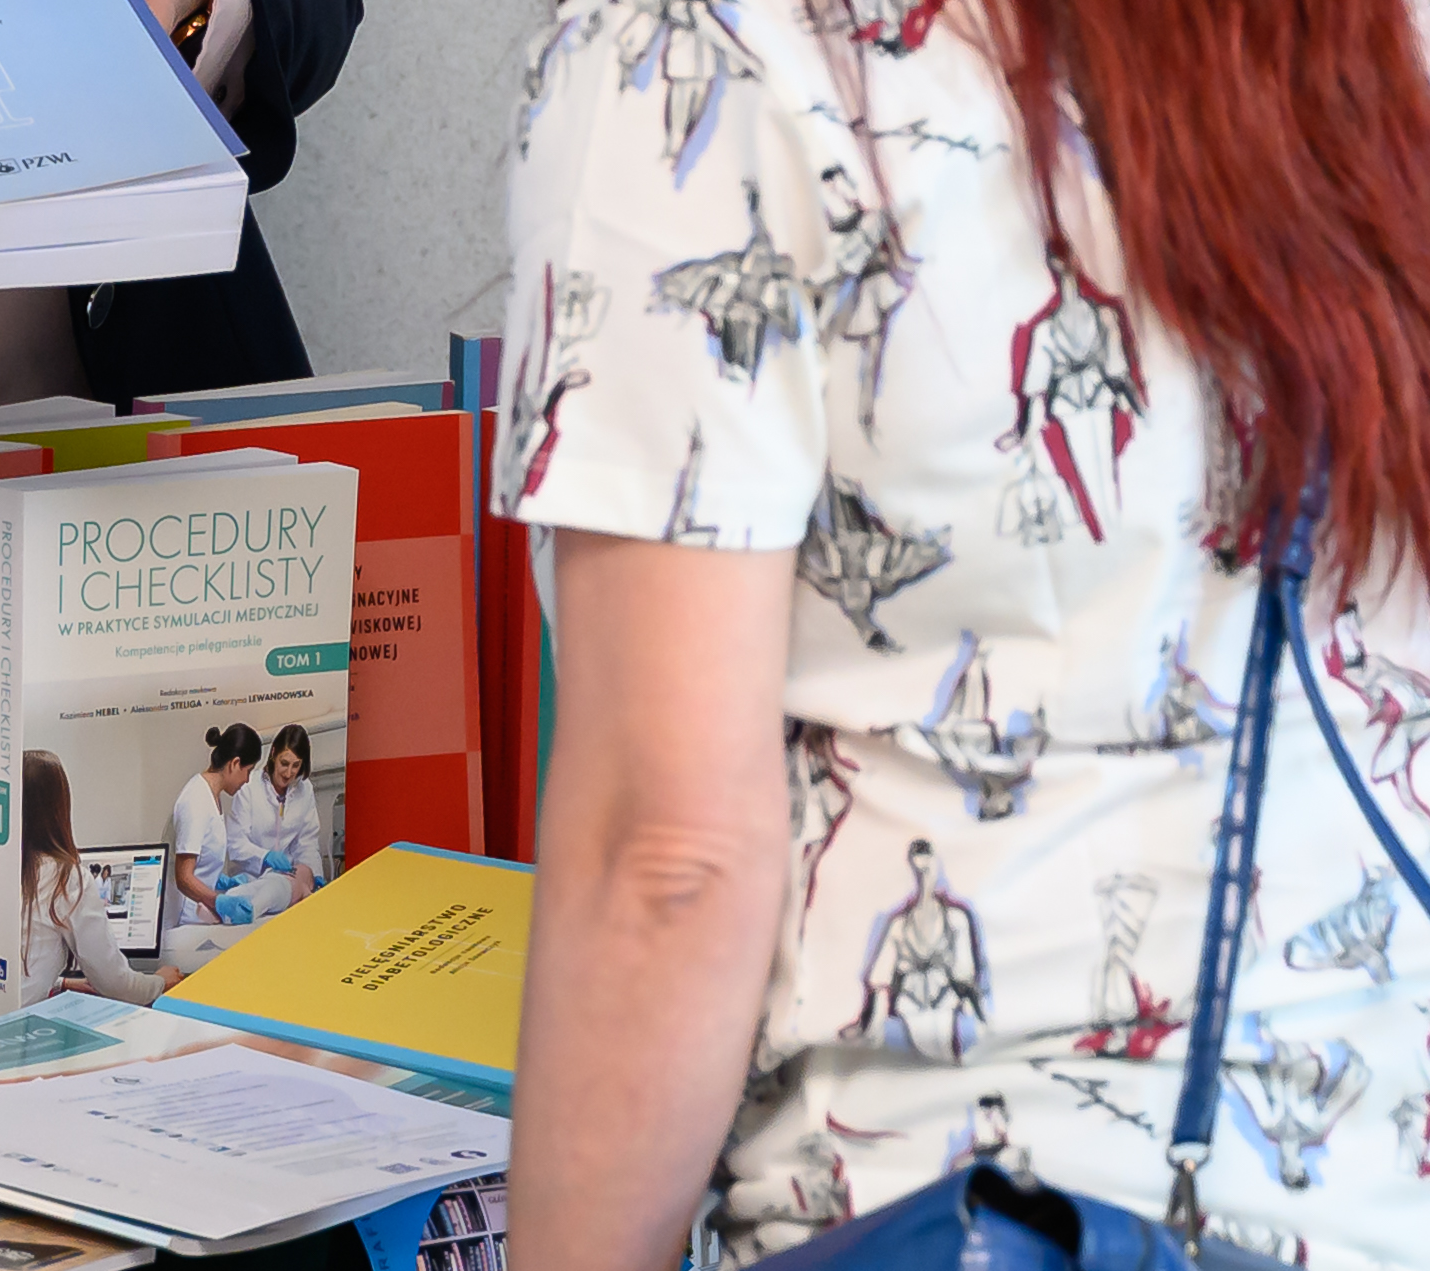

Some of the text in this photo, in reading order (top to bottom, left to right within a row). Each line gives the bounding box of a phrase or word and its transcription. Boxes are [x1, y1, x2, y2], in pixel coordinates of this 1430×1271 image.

[21, 150, 78, 172] PZWL
[57, 504, 328, 567] PROCEDURY
[0, 519, 13, 641] PROCEDURY
[57, 554, 325, 614] I CHECKLISTY
[58, 603, 319, 636] W PRAKTYCE SYMULACJI MEDYCZNEJ
[115, 635, 262, 660] Kompetencje pielęgniarskie
[276, 651, 321, 669] TOM 1
[0, 657, 12, 777] CHECKLISTY
[95, 707, 120, 717] HEBEL
[170, 700, 202, 710] STELIGA
[248, 690, 314, 703] LEWANDOWSKA
[341, 904, 467, 985] PIELĘGNIARSTWO
[362, 906, 494, 991] DIABETOLOGICZNE
